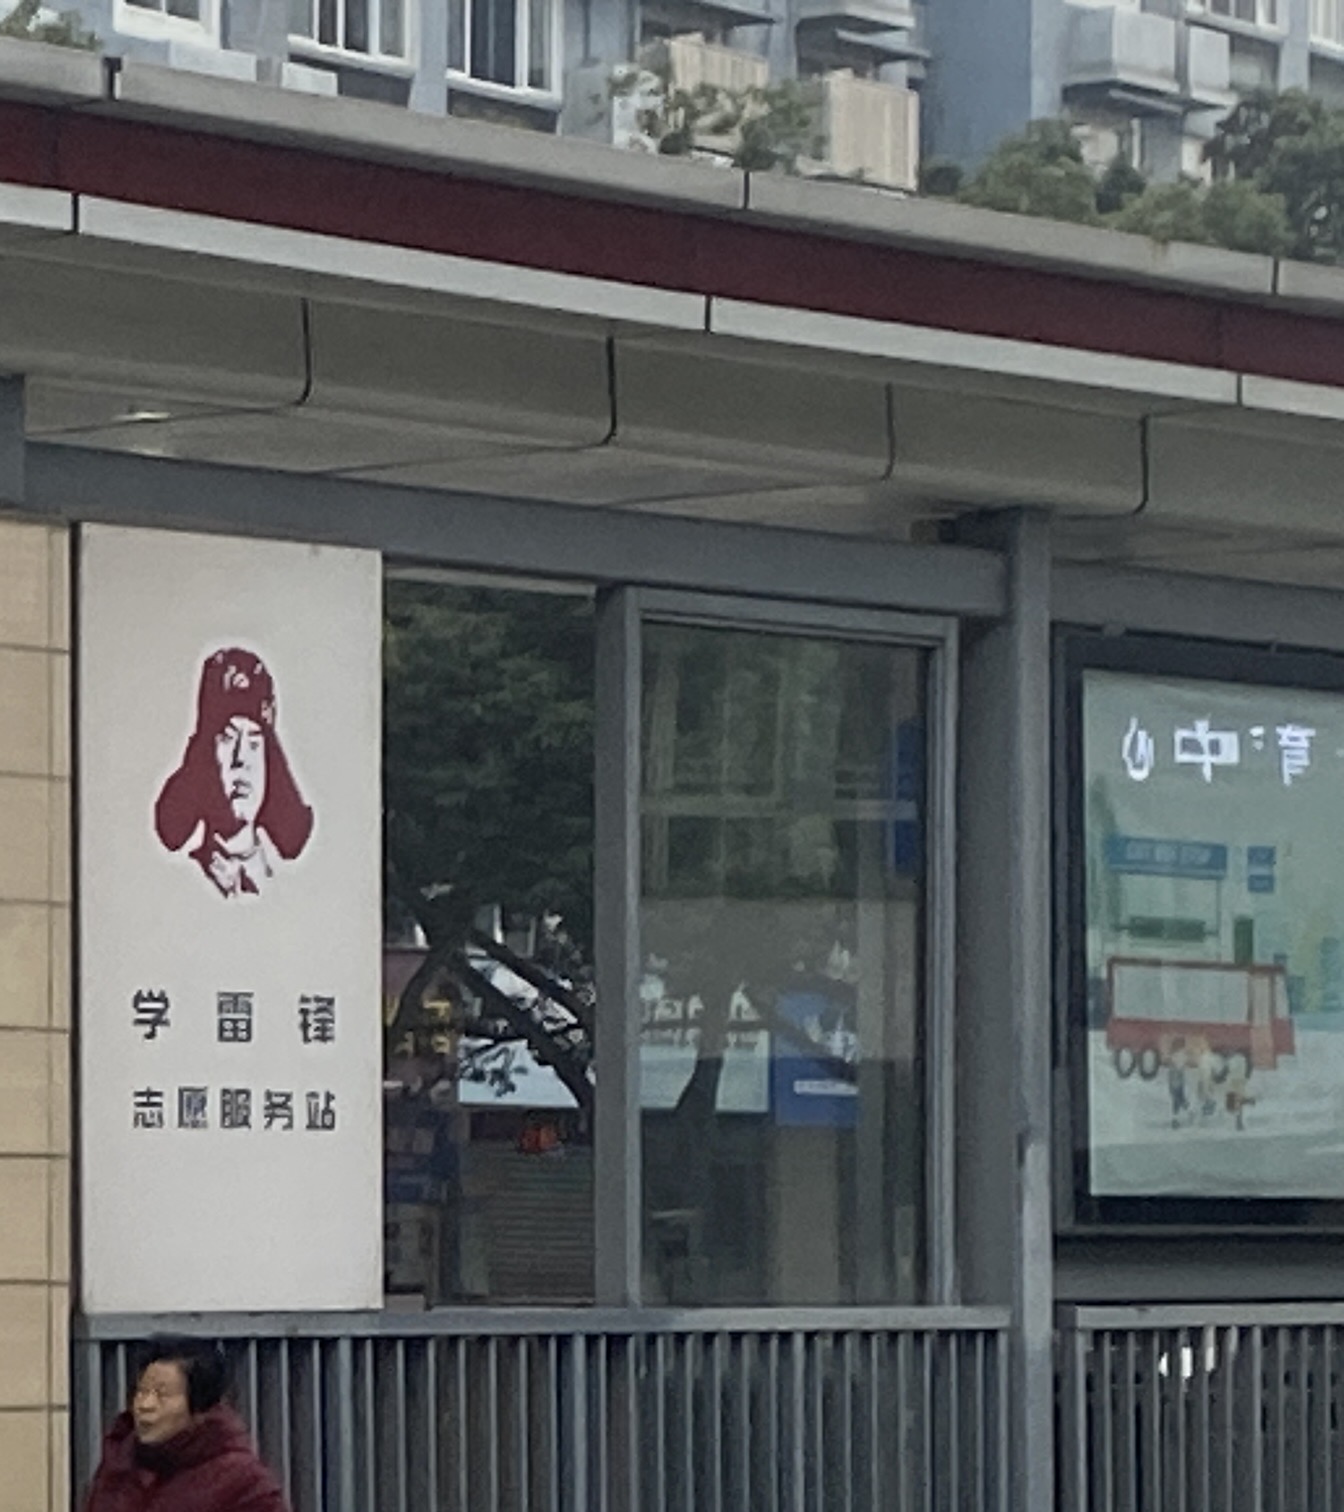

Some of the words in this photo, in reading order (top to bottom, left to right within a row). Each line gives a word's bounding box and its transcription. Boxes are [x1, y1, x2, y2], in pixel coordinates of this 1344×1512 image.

[132, 989, 335, 1043] 学雷锋
[132, 1086, 336, 1131] 志愿服务站
